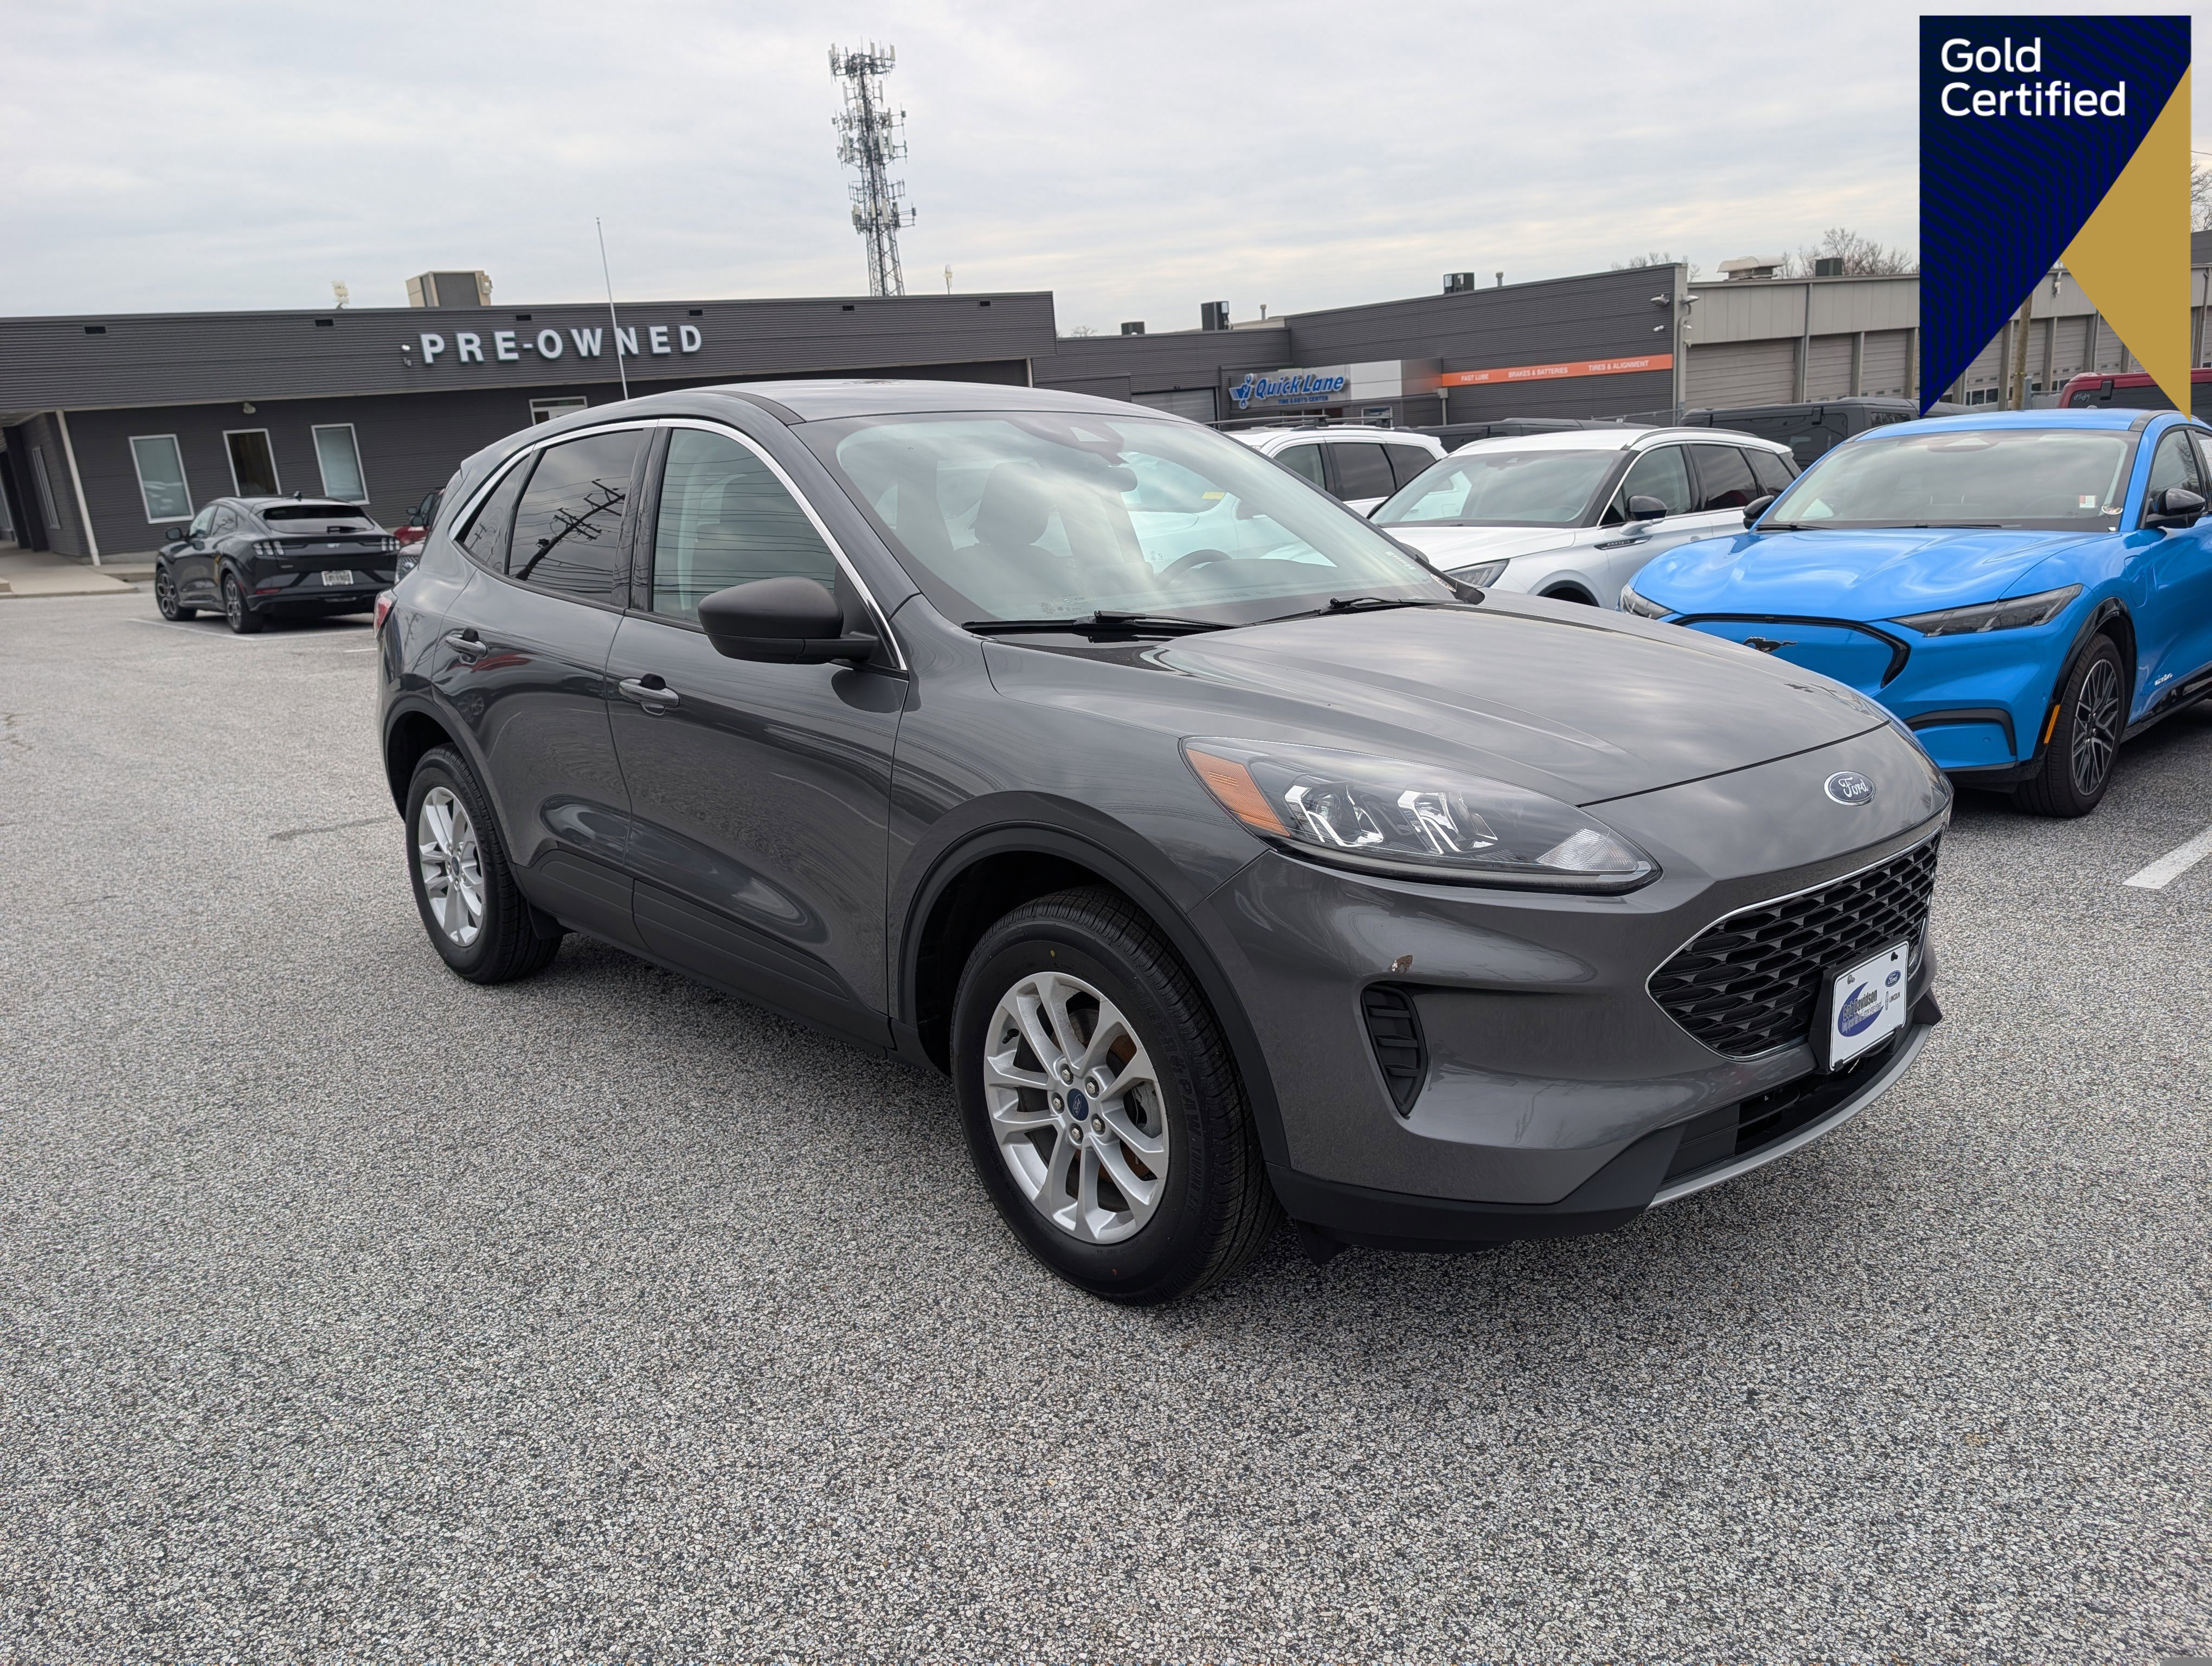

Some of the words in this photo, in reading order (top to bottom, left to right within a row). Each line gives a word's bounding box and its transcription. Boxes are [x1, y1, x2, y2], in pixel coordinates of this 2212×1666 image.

[420, 325, 702, 364] PRE-OWNED
[1508, 370, 1531, 378] BRAKES
[1536, 367, 1568, 375] BATTERIES
[1588, 363, 1606, 371] TIRES
[1612, 360, 1649, 369] ALIGNMENT
[1255, 375, 1302, 399] Quick
[1302, 374, 1345, 393] Lane
[1838, 776, 1869, 798] Ford
[1887, 973, 1899, 985] Ford
[1854, 989, 1877, 1015] Davidson
[1178, 1078, 1202, 1137] PAW
